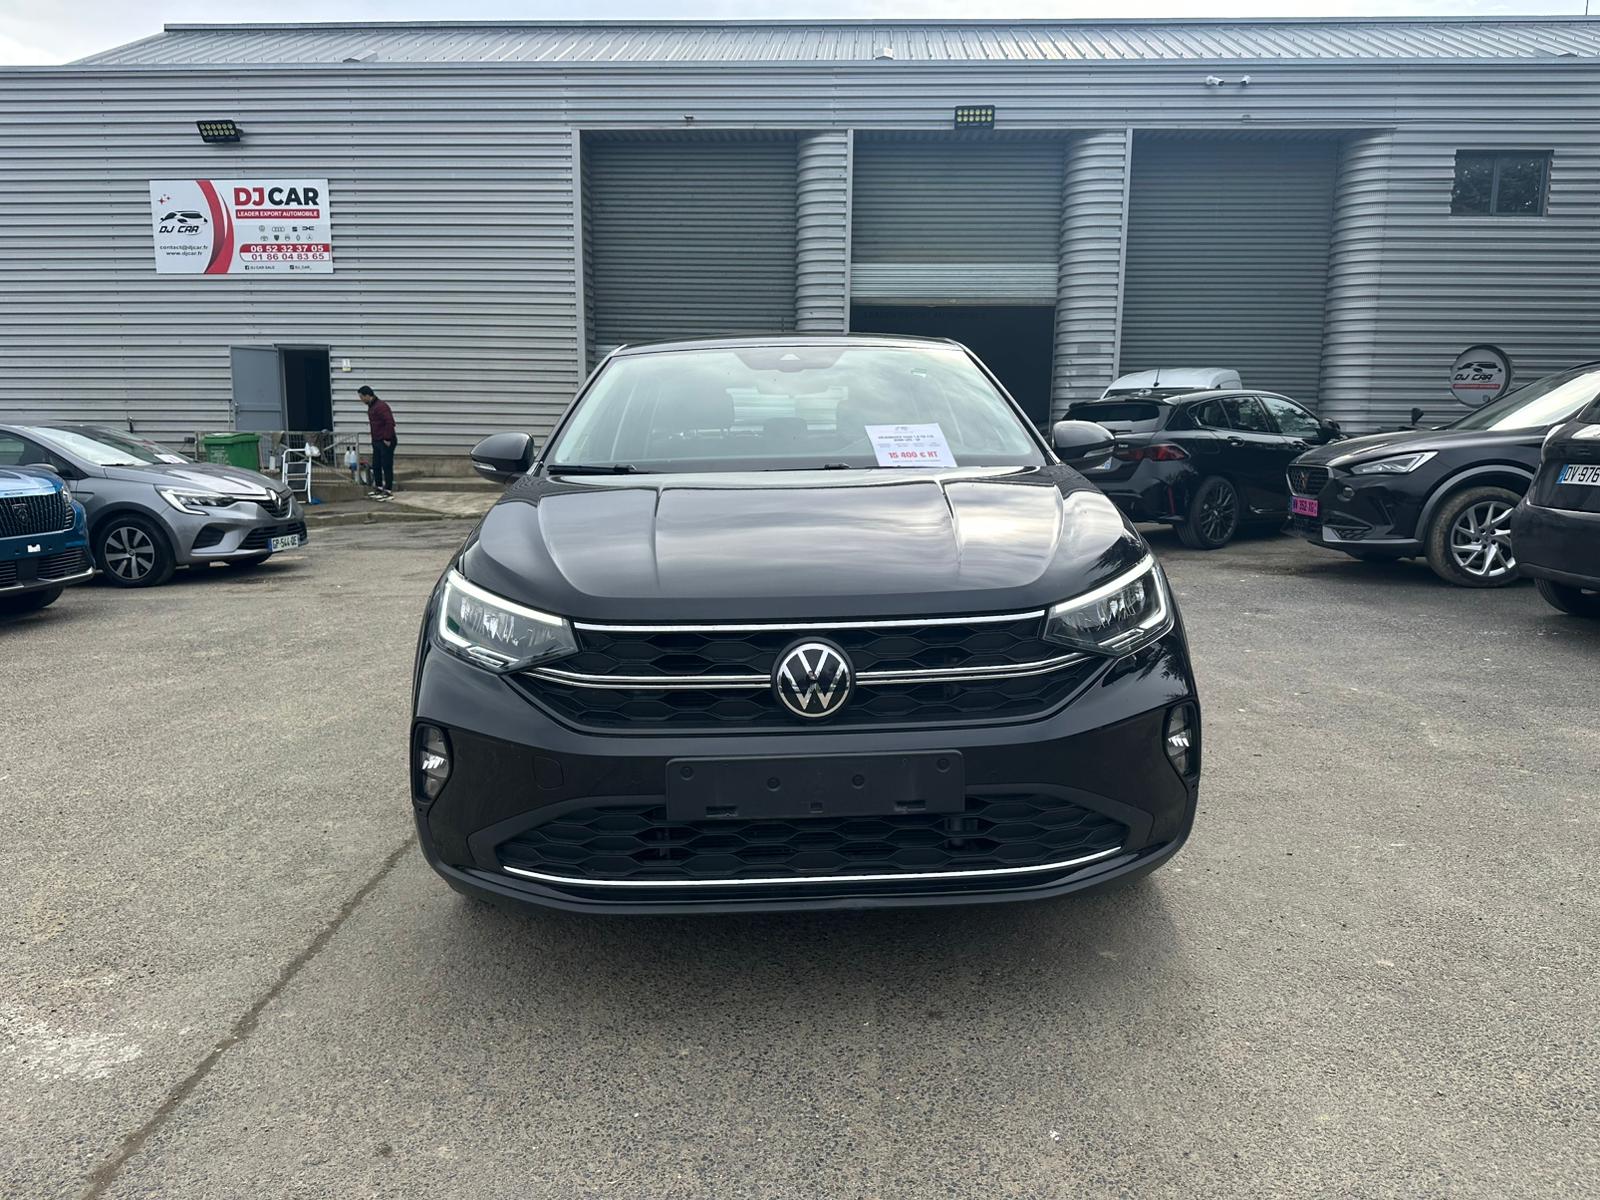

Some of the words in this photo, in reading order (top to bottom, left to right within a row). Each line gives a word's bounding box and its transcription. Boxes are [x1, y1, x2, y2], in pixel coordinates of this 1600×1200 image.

[234, 187, 265, 206] DJ
[268, 187, 319, 206] CAR
[159, 225, 175, 233] DJ
[177, 225, 200, 233] CAR
[250, 244, 263, 252] 06
[266, 244, 278, 252] 52
[280, 244, 293, 252] 32
[296, 244, 308, 252] 37
[311, 244, 324, 252] 05
[251, 253, 263, 261] 01
[266, 253, 279, 261] 86
[281, 253, 294, 261] 04
[297, 253, 309, 261] 83
[312, 252, 325, 260] 65
